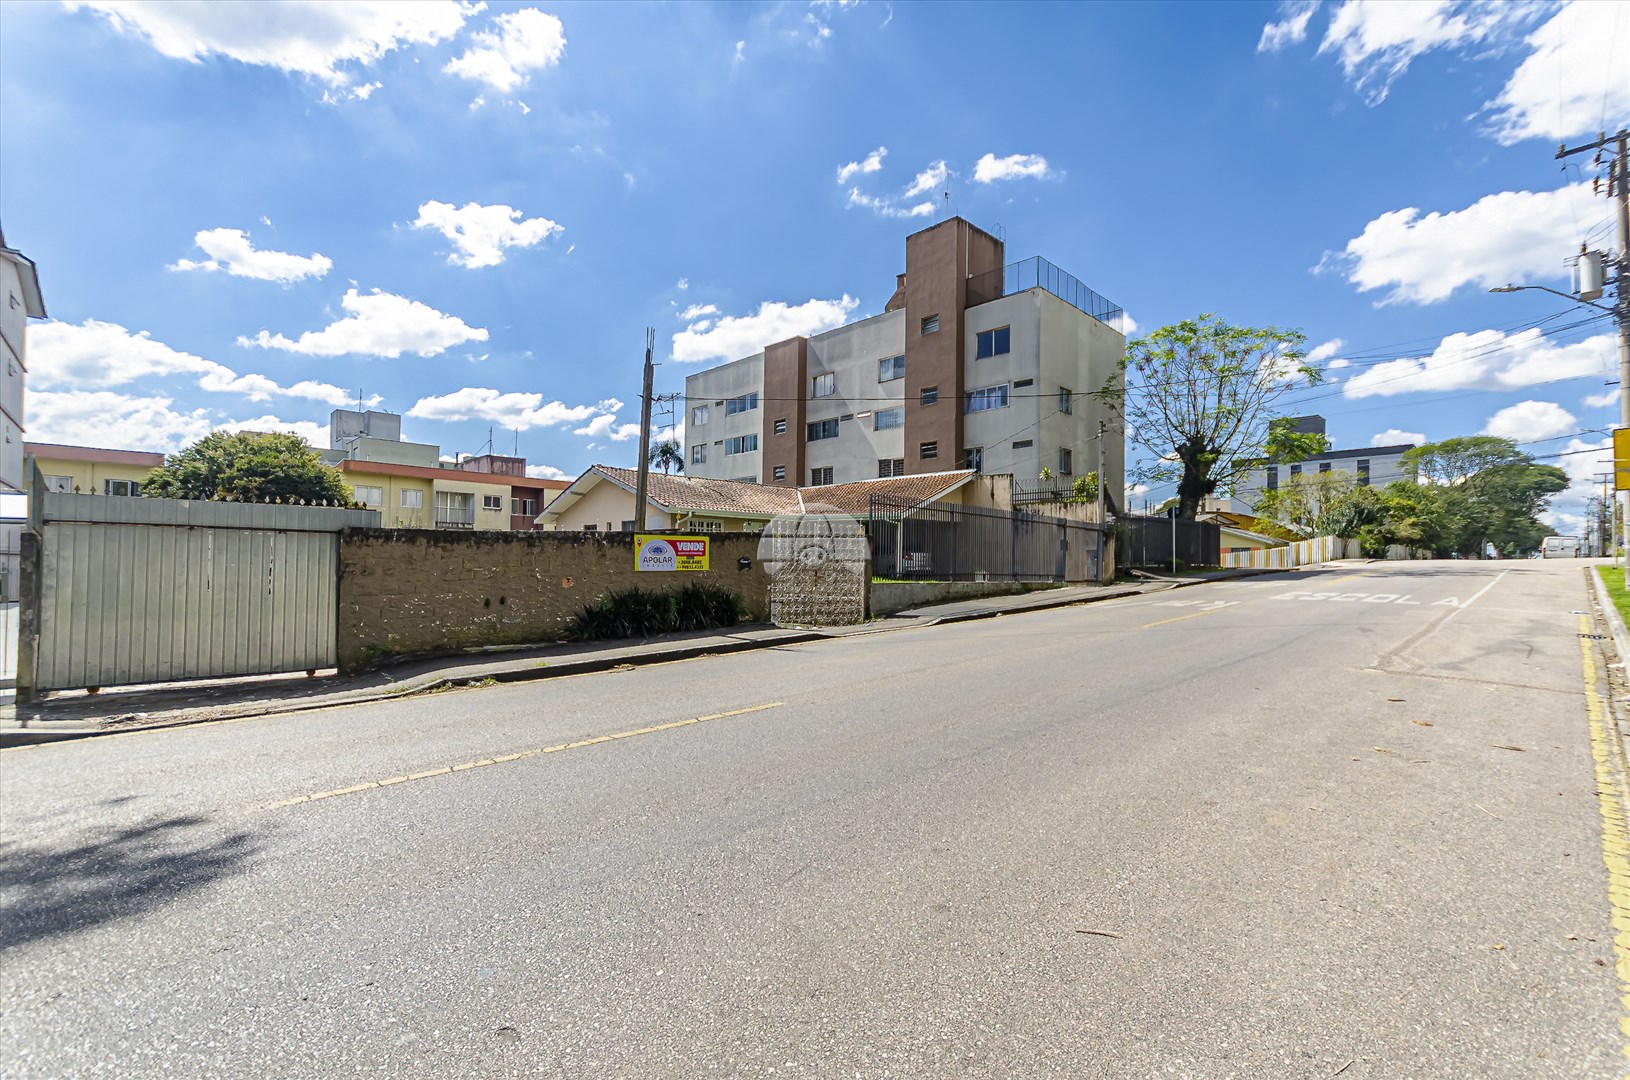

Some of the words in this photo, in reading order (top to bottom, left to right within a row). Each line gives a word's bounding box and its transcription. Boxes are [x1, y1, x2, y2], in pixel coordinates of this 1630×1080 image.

[676, 542, 704, 551] VENDE
[642, 556, 673, 564] APOLAR
[1270, 591, 1460, 608] ESCOLA
